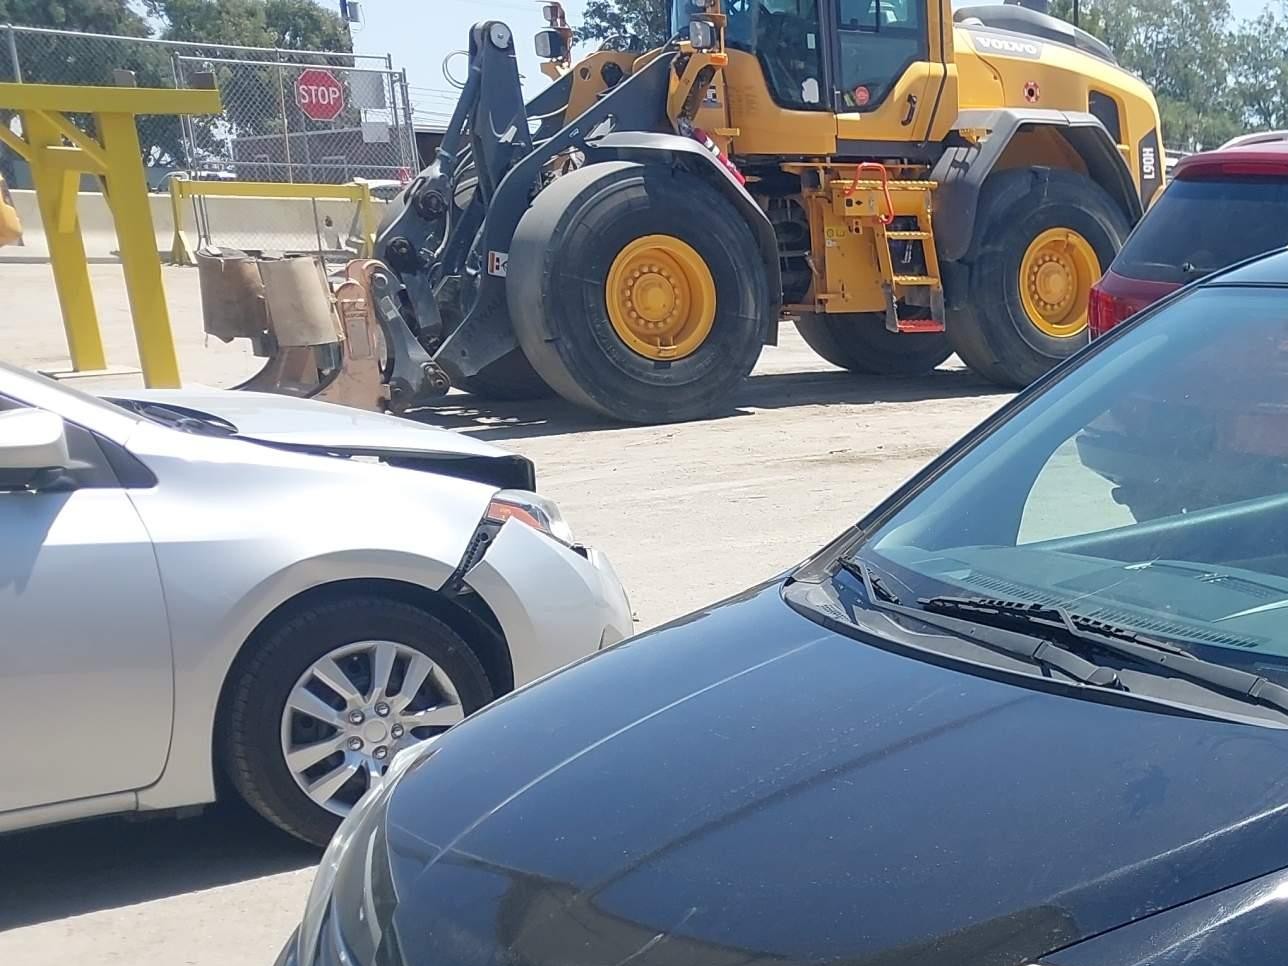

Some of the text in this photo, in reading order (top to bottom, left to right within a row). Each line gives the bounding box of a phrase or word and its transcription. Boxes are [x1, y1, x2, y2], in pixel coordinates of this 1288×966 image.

[975, 36, 1037, 54] VOLVO
[299, 84, 340, 105] STOP
[1142, 147, 1155, 180] L90H
